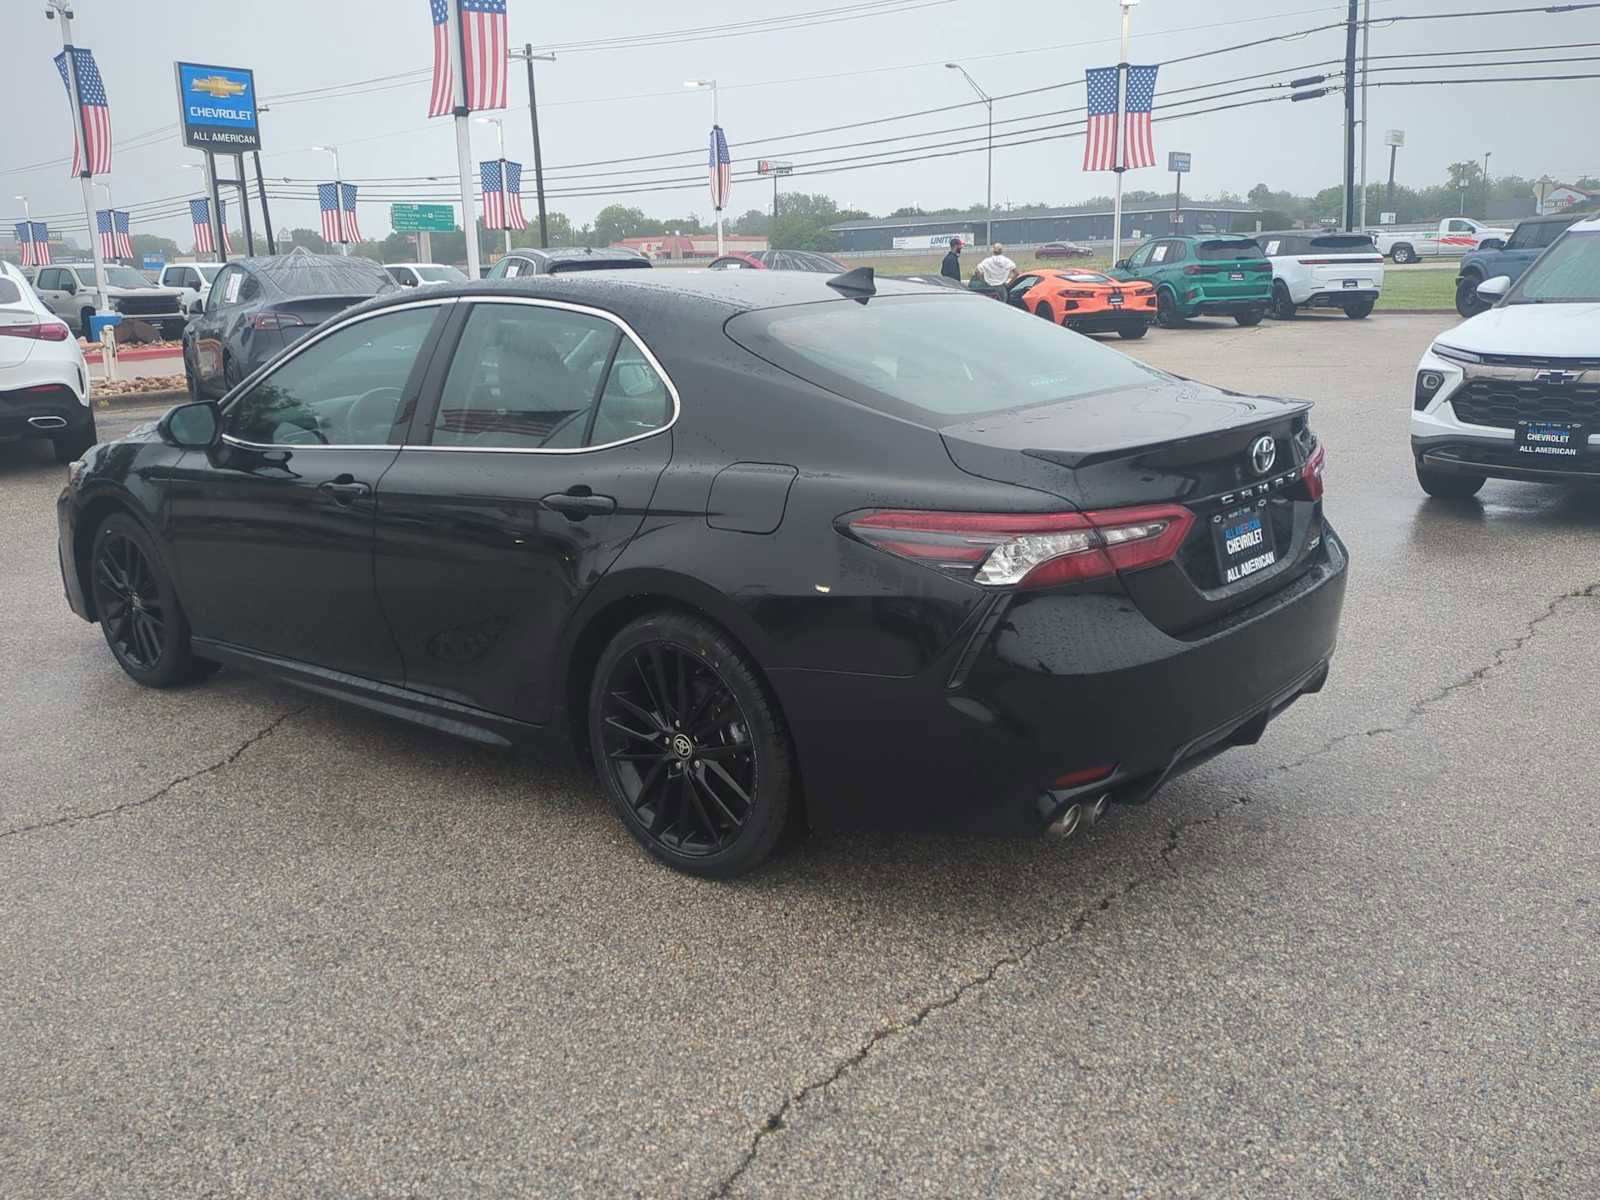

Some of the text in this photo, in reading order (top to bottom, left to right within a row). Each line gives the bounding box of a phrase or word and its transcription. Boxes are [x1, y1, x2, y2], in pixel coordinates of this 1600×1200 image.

[190, 106, 252, 120] CHEVROLET
[193, 131, 256, 144] ALL AMERICAN
[1527, 433, 1569, 443] CHEVROLET
[1535, 447, 1577, 456] AMERICAN
[1226, 528, 1263, 555] CHEVROLET
[1227, 551, 1275, 583] ALL AMERICAN
